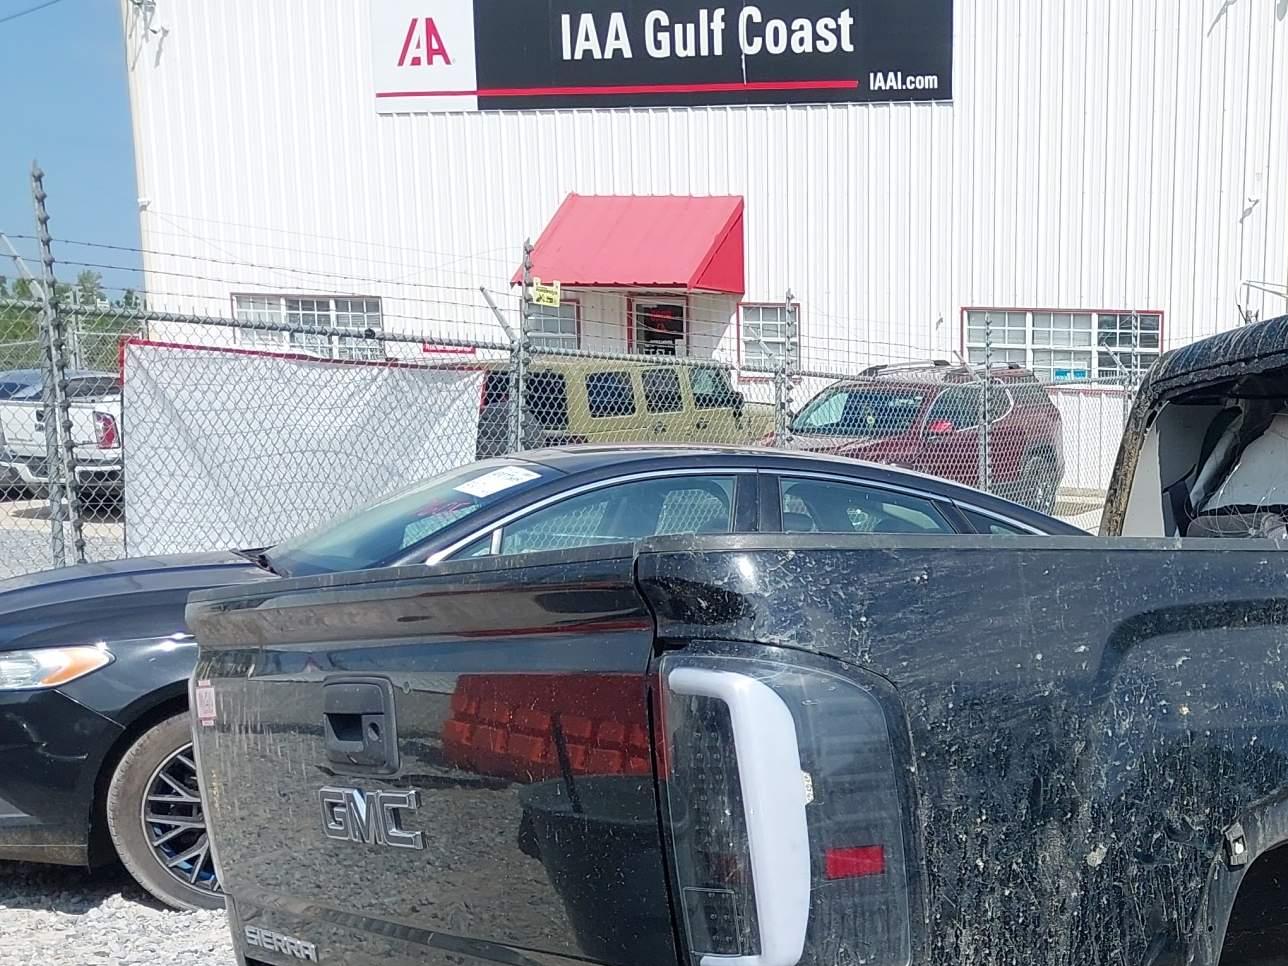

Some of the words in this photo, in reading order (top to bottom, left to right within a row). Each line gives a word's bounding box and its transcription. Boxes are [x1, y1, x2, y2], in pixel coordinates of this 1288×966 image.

[562, 13, 632, 59] IAA
[645, 11, 725, 58] Gulf
[742, 8, 855, 54] Coast
[869, 73, 938, 91] IAAI.com
[319, 786, 427, 849] GMC
[244, 926, 318, 962] SIERRA
